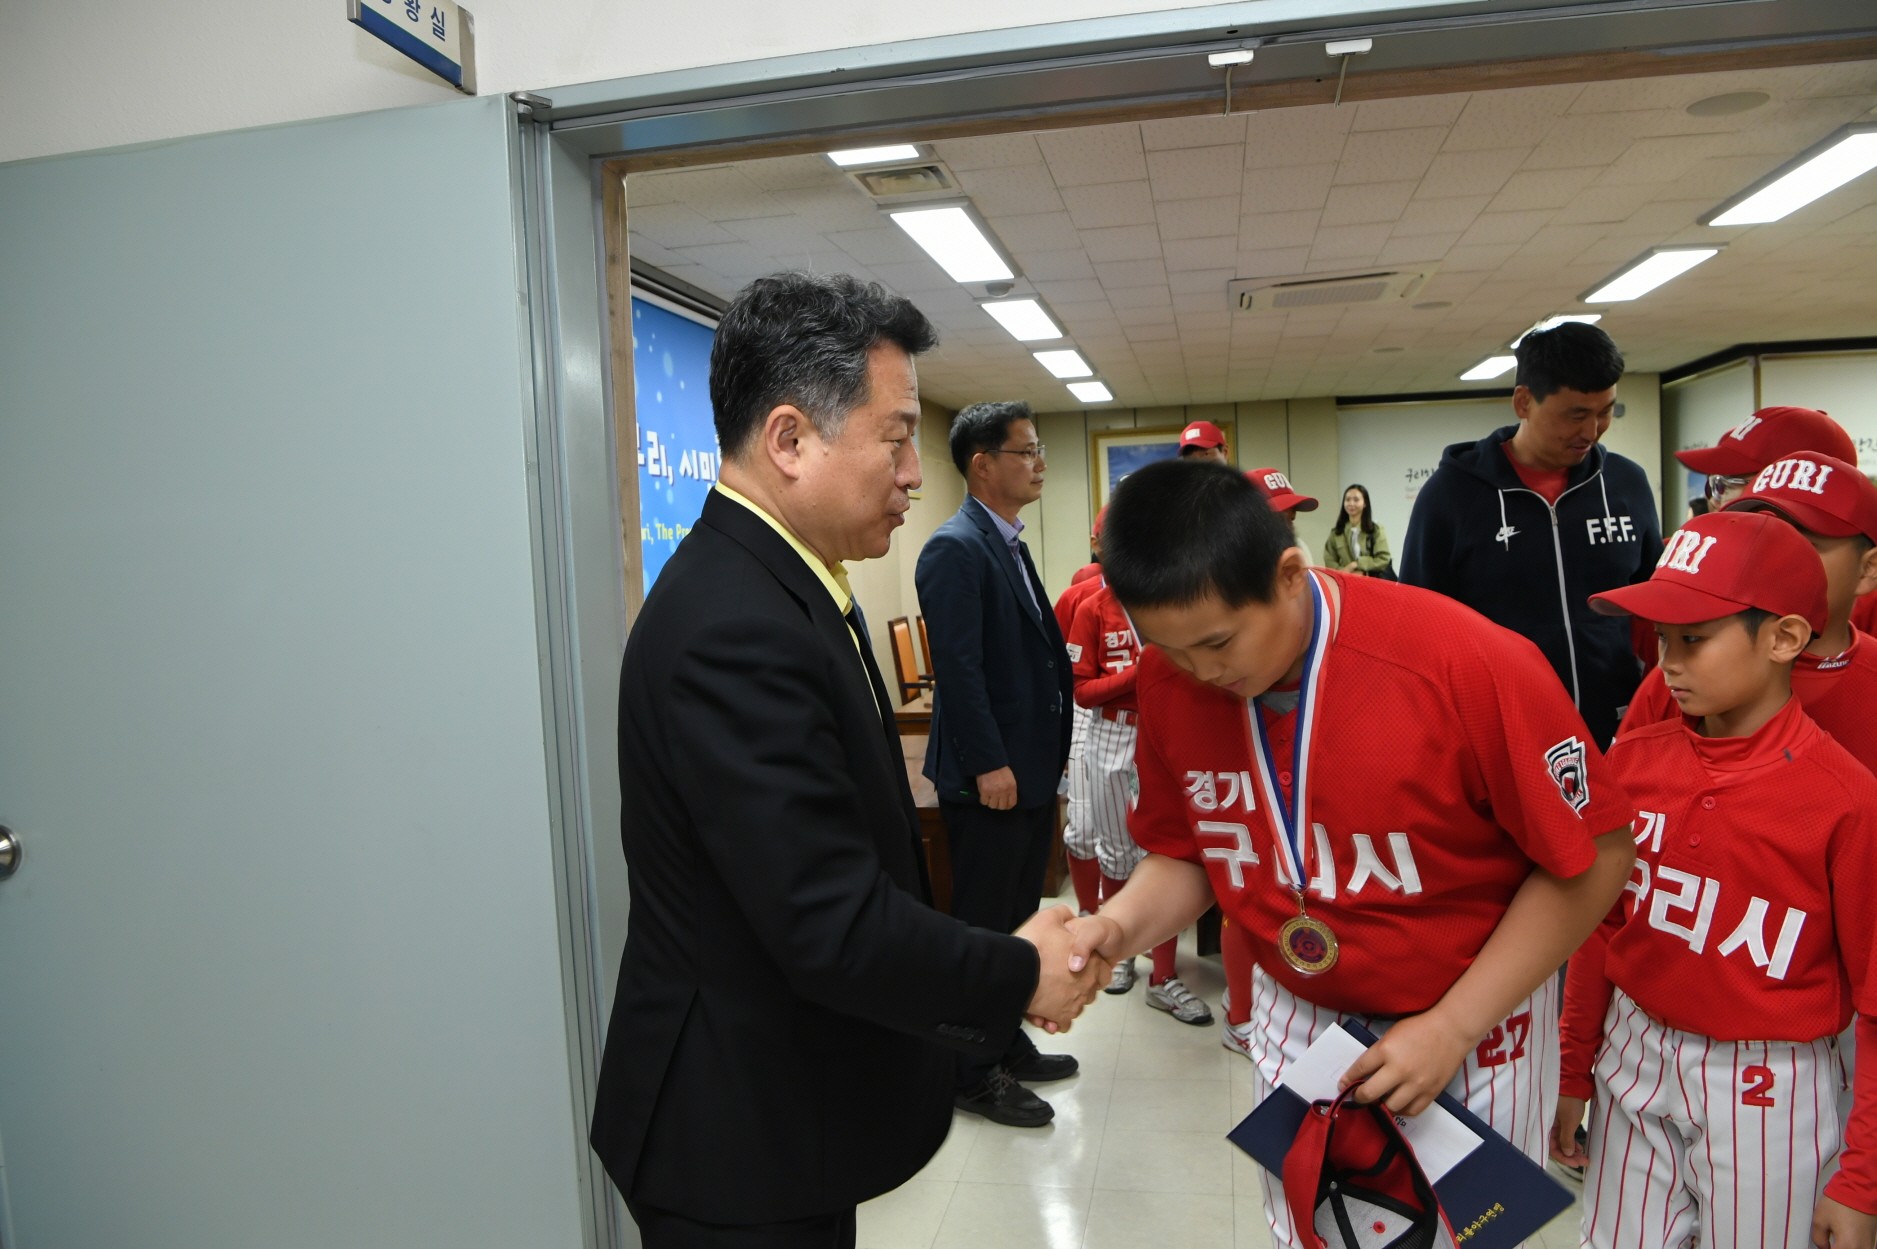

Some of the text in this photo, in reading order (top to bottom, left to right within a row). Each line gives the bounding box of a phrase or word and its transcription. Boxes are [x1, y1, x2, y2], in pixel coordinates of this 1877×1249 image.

[382, 0, 446, 42] 황실
[1263, 472, 1294, 490] GU
[1752, 458, 1833, 495] GURI
[655, 523, 674, 540] The
[1586, 516, 1637, 545] F.F.F.
[1105, 629, 1133, 648] 경기
[1185, 770, 1256, 811] 경기
[1630, 810, 1666, 853] 기
[1476, 1011, 1531, 1068] 27
[1741, 1065, 1776, 1108] 2
